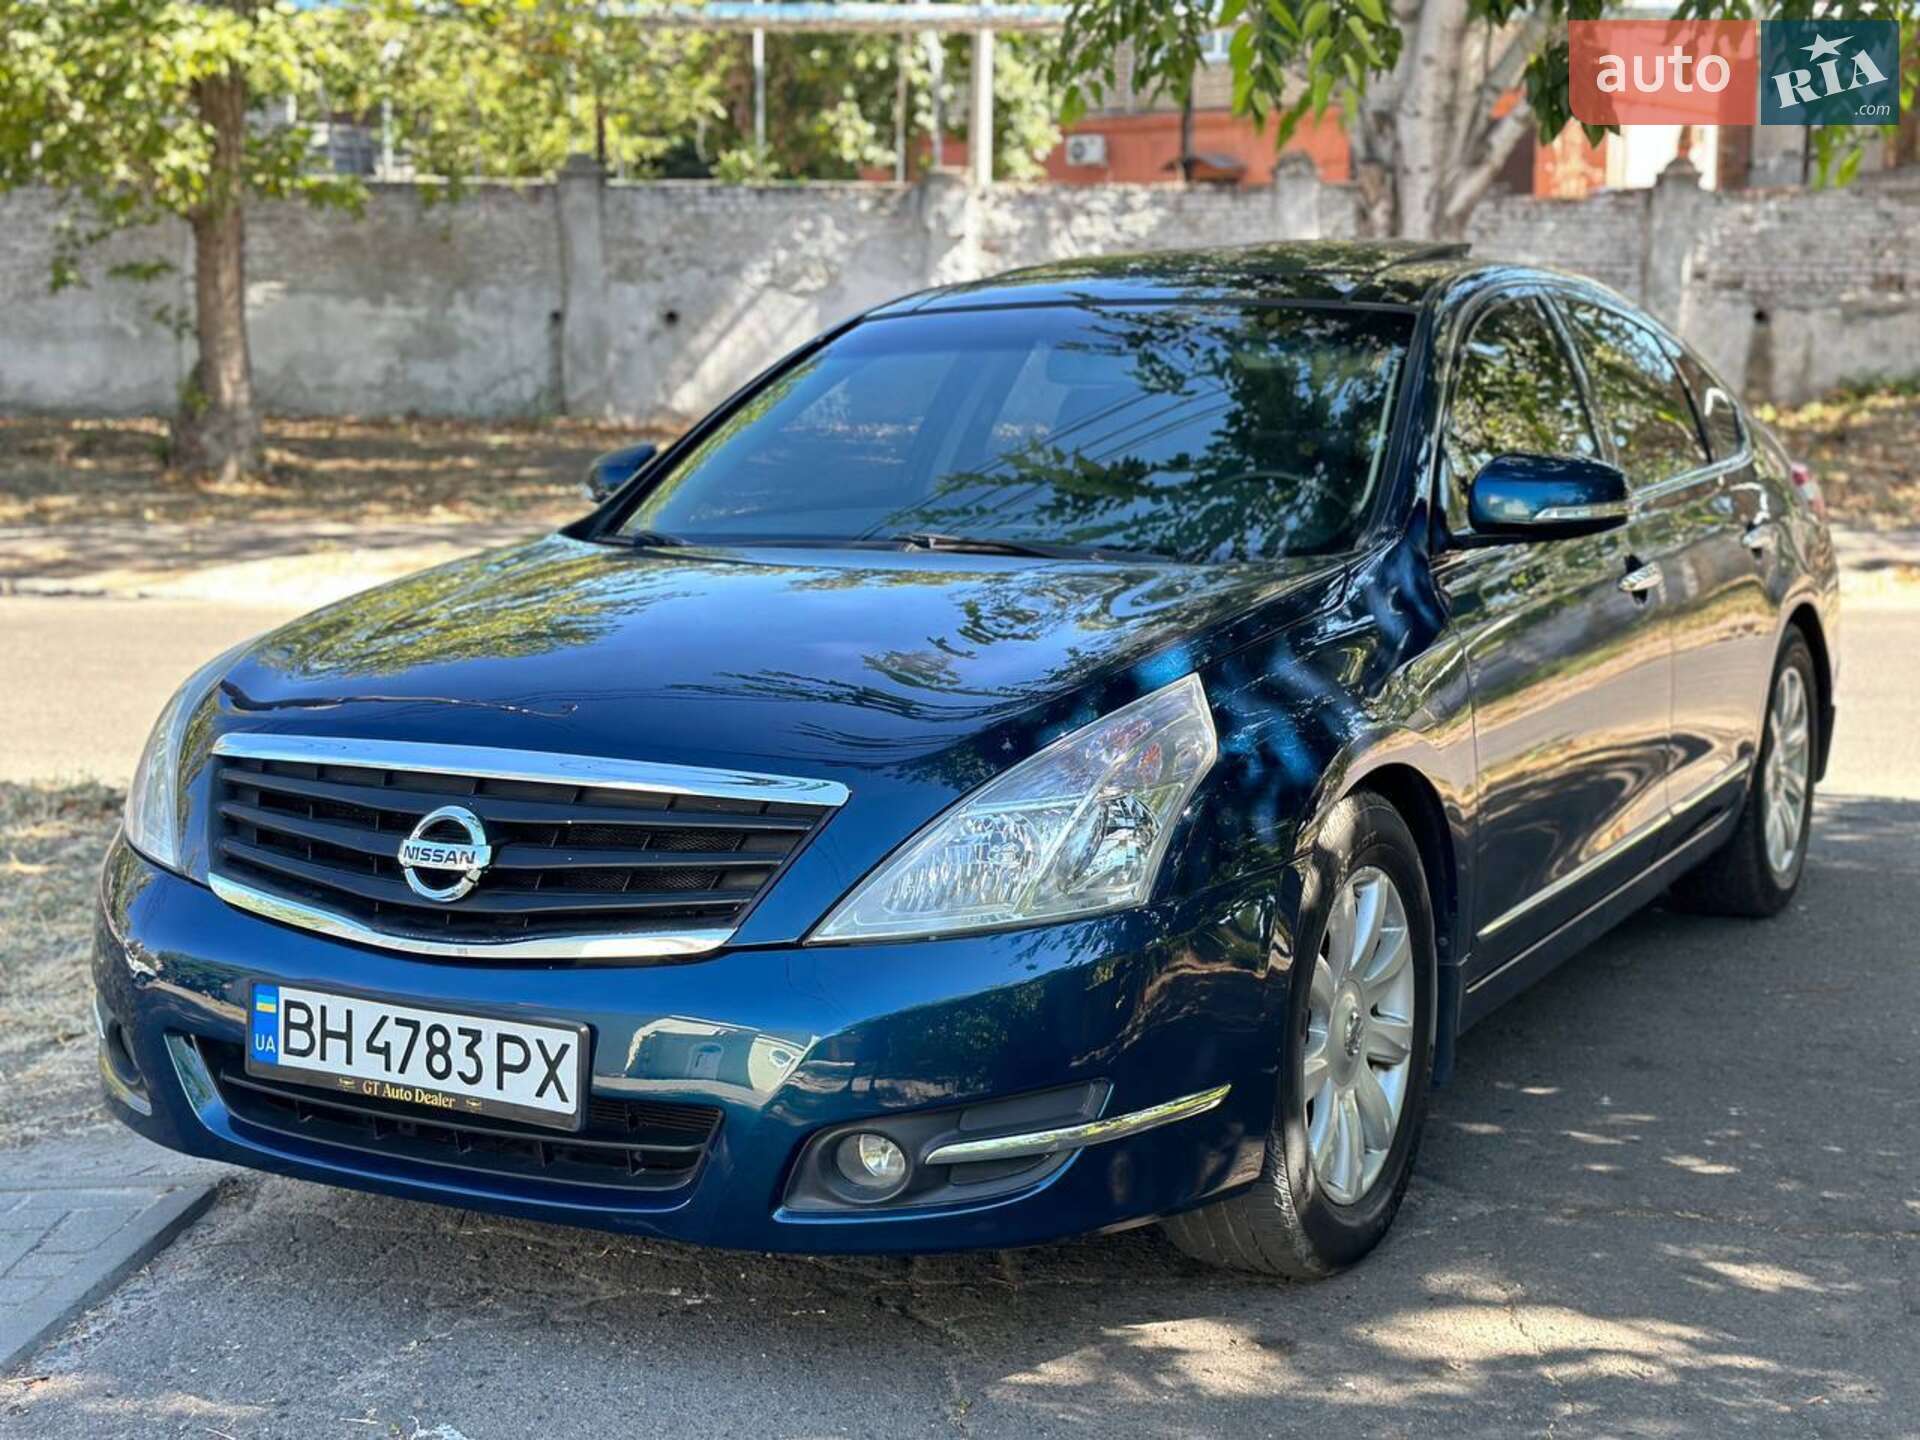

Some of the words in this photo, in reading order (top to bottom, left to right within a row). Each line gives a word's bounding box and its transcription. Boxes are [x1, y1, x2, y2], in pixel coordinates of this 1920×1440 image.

[403, 845, 476, 865] NISSAN
[255, 1034, 276, 1054] UA
[283, 999, 353, 1066] BH
[365, 1014, 483, 1086] 4783
[496, 1032, 570, 1103] PX
[363, 1080, 380, 1096] GT
[382, 1083, 412, 1102] Auto
[414, 1088, 457, 1109] Dealer
